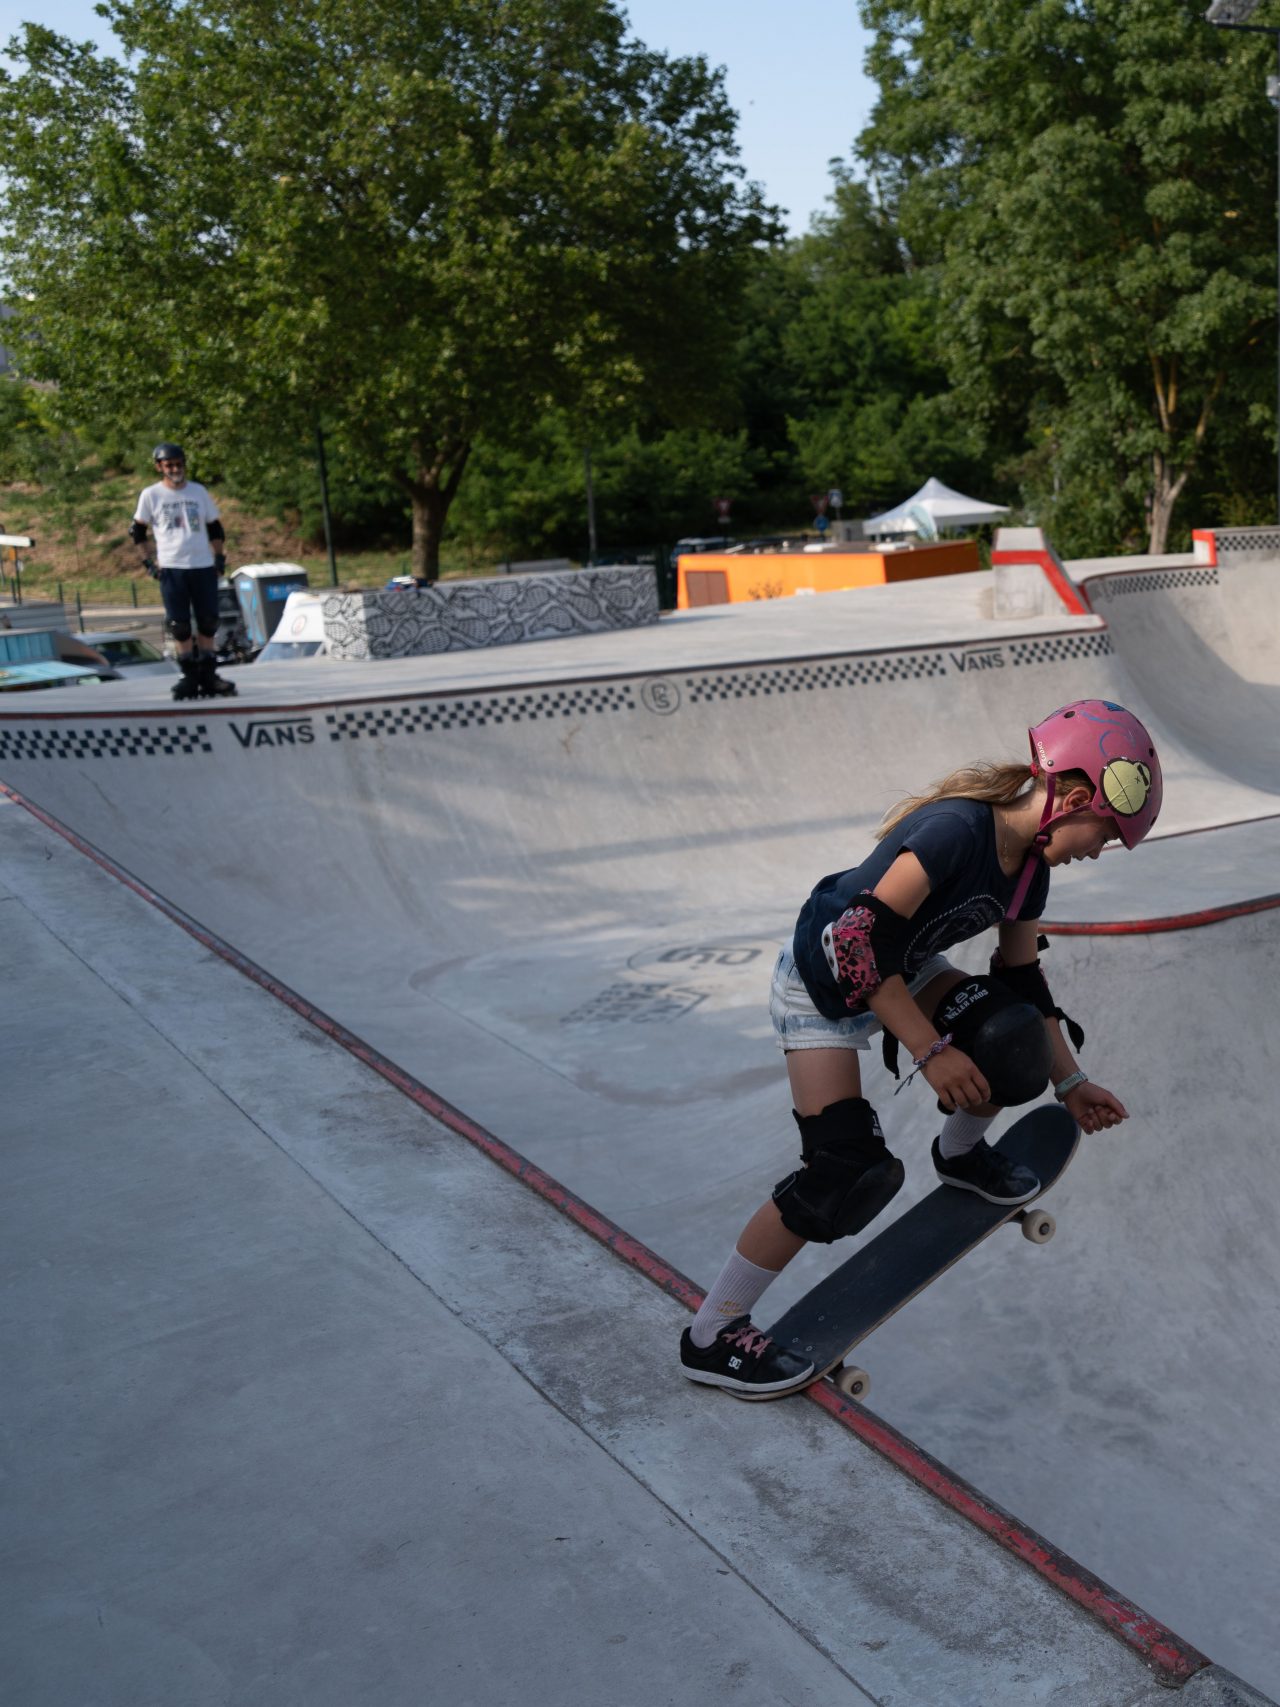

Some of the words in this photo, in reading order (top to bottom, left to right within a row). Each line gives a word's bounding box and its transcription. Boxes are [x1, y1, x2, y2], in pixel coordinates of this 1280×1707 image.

[948, 646, 1005, 672] VANS
[228, 718, 315, 748] VANS
[945, 983, 979, 1014] 187
[969, 989, 989, 1003] PADS
